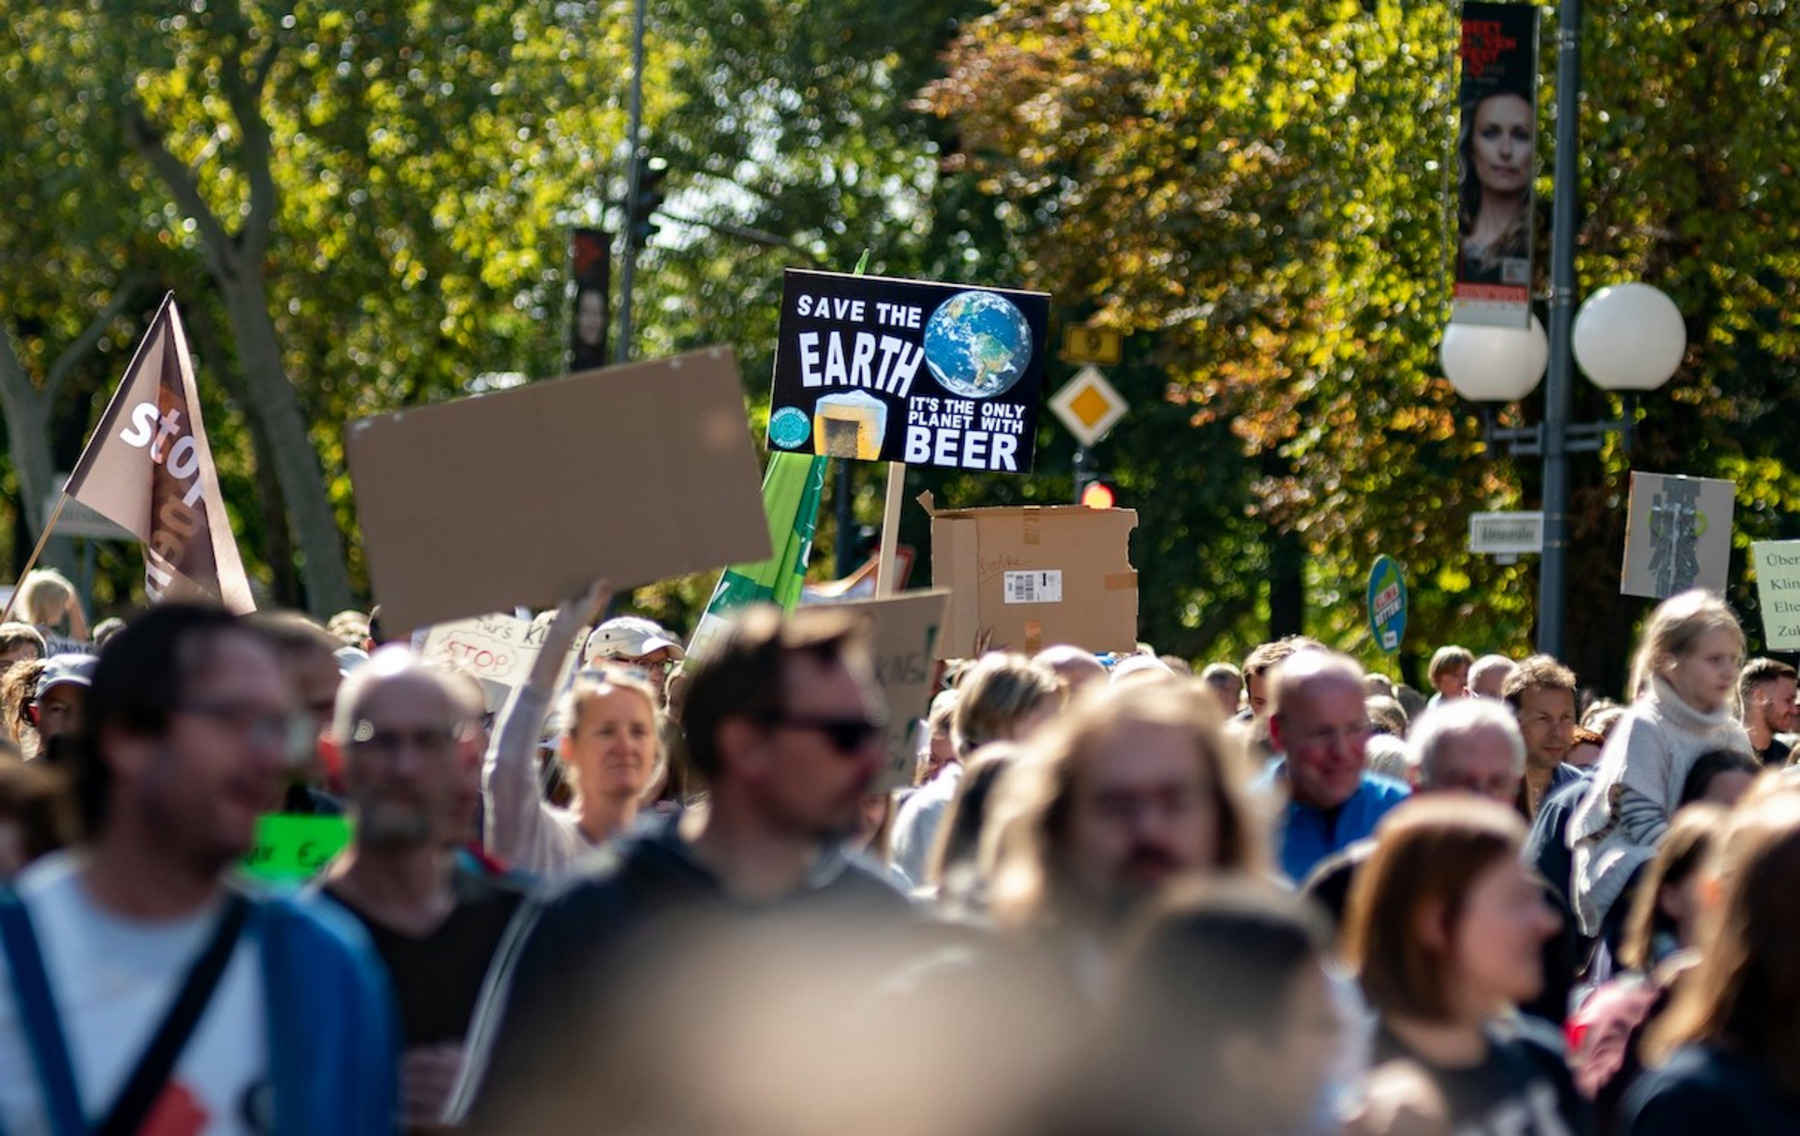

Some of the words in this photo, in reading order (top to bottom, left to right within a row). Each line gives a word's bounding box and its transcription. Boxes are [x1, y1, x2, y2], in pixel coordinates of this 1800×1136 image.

[797, 295, 865, 322] SAVE
[876, 303, 922, 329] THE
[799, 331, 925, 398] EARTH
[908, 411, 973, 429] PLANET
[981, 416, 1024, 433] WITH
[910, 396, 938, 413] IT'S
[944, 398, 975, 414] THE
[981, 402, 1026, 419] ONLY
[904, 426, 1018, 471] BEER
[448, 641, 508, 672] STOP
